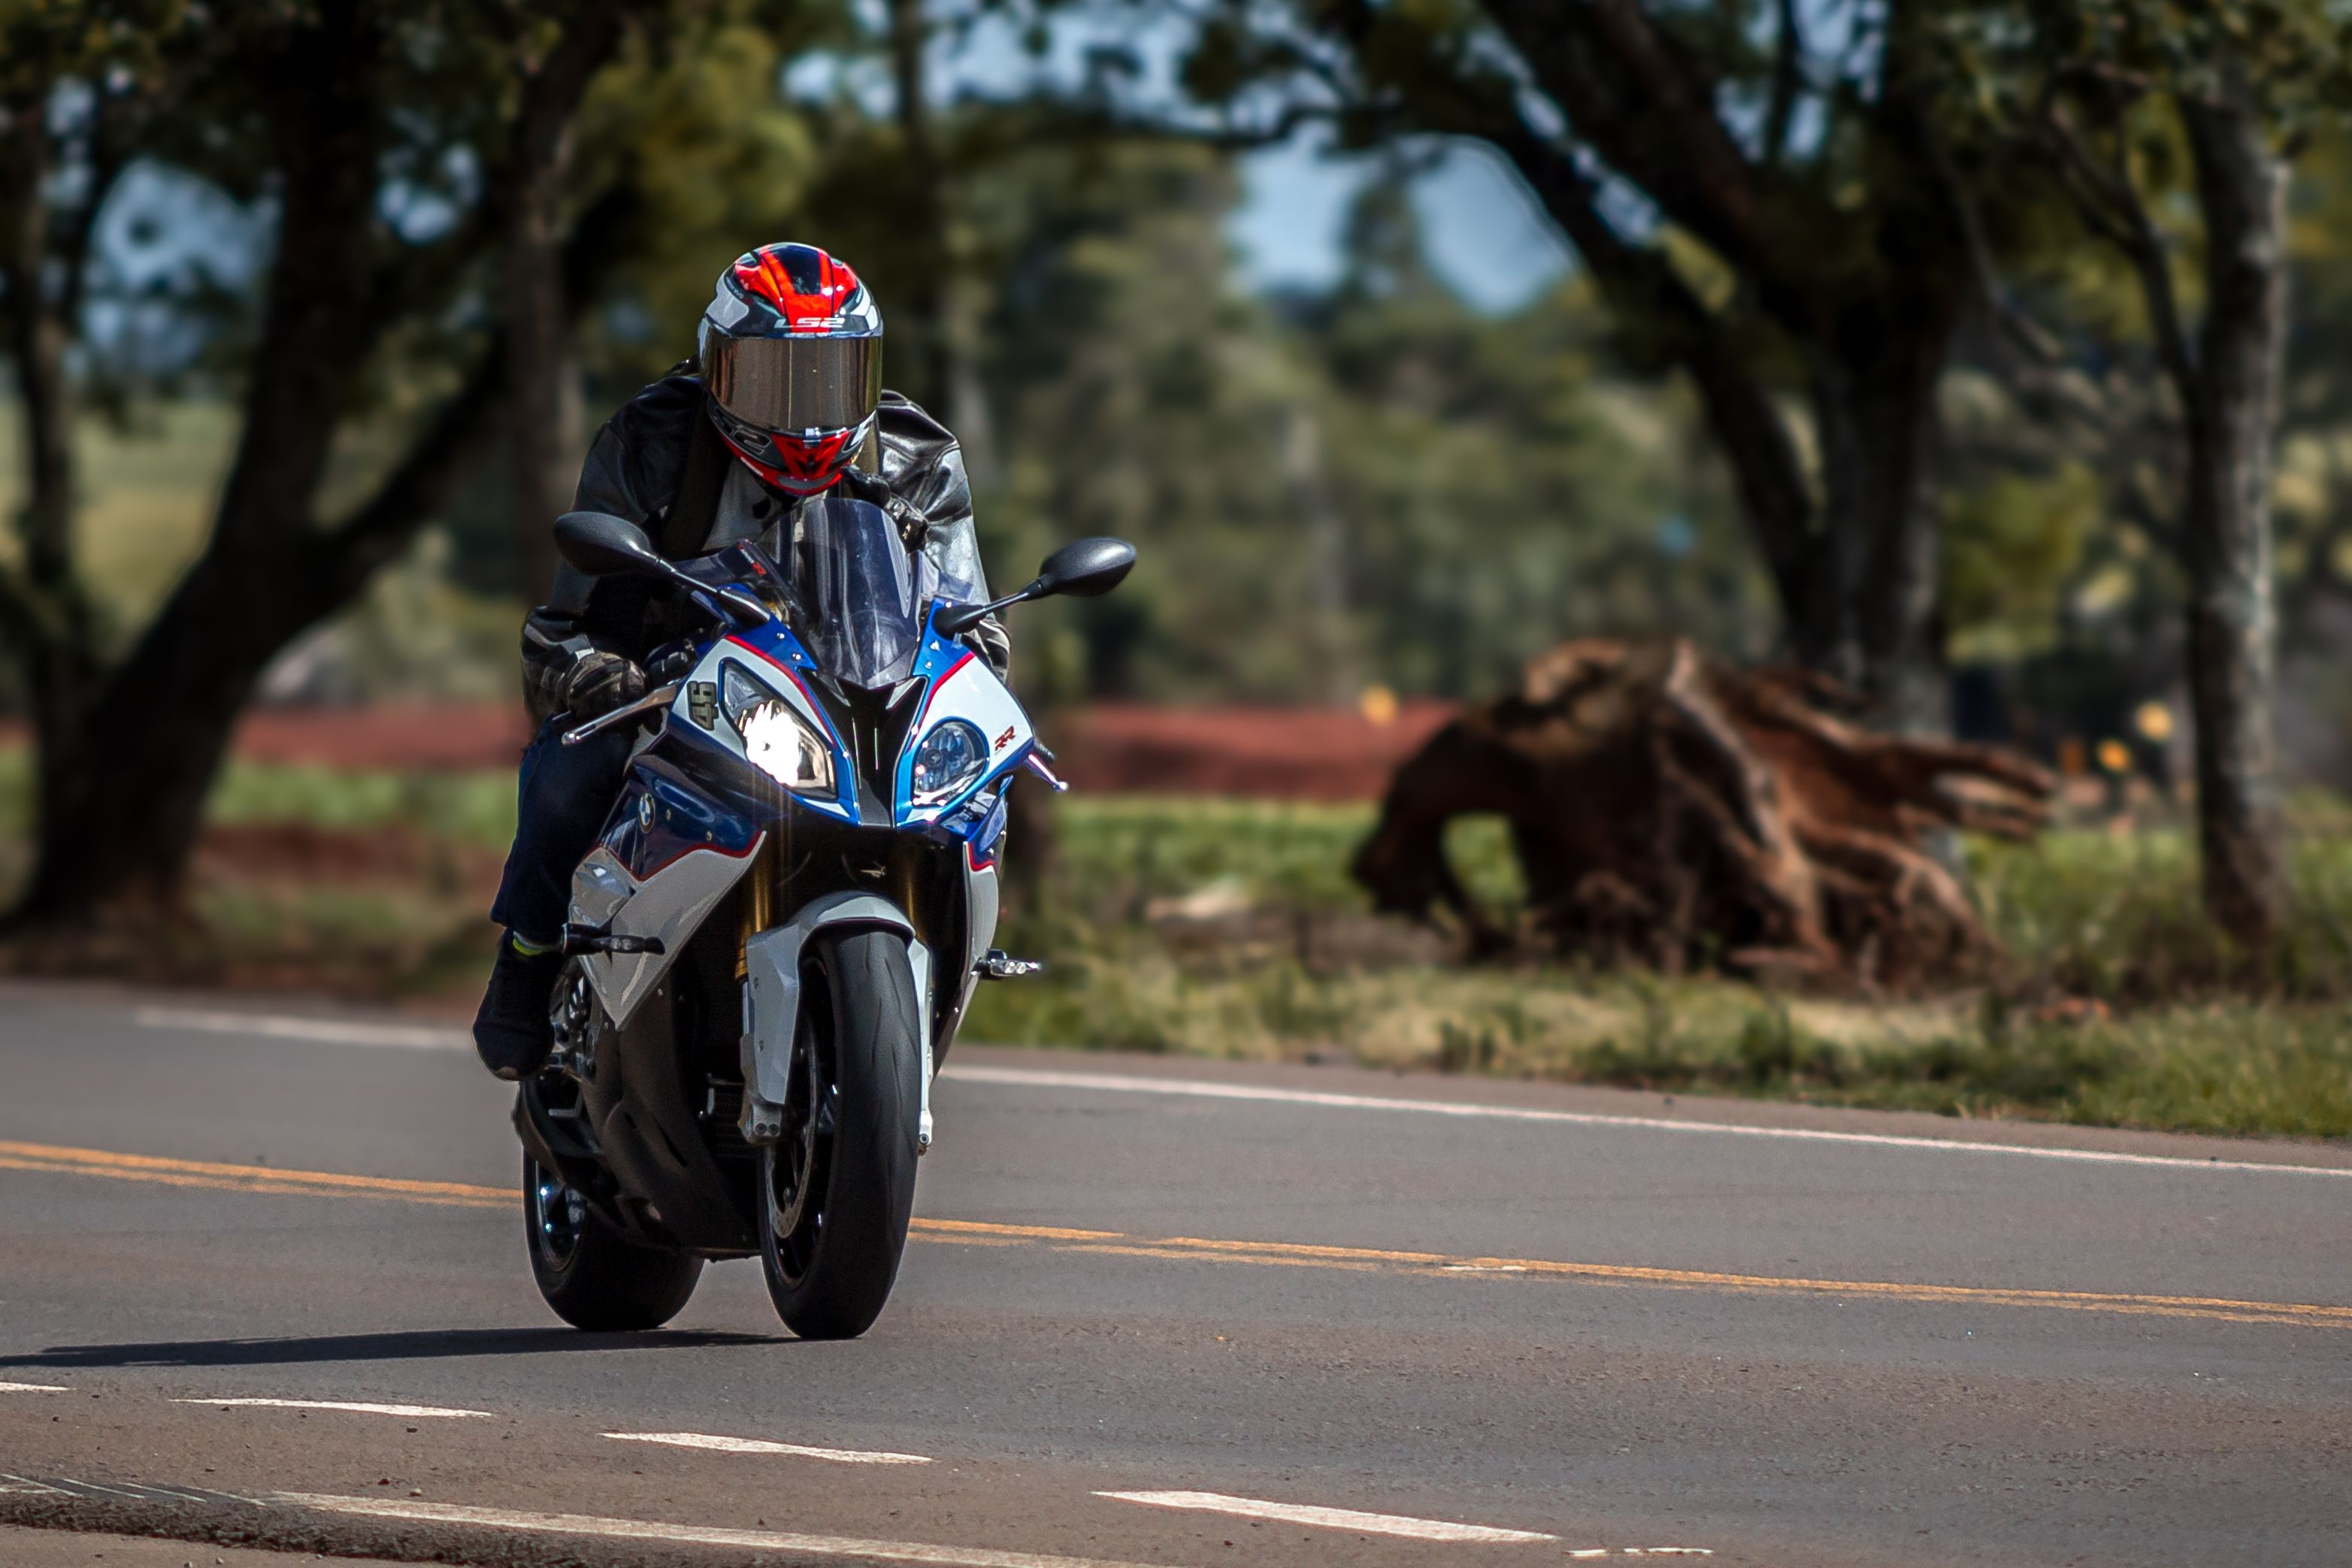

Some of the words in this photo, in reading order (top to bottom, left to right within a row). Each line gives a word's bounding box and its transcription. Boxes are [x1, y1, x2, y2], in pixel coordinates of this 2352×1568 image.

[773, 317, 845, 328] LS2
[687, 681, 719, 731] 46
[994, 725, 1016, 751] RR
